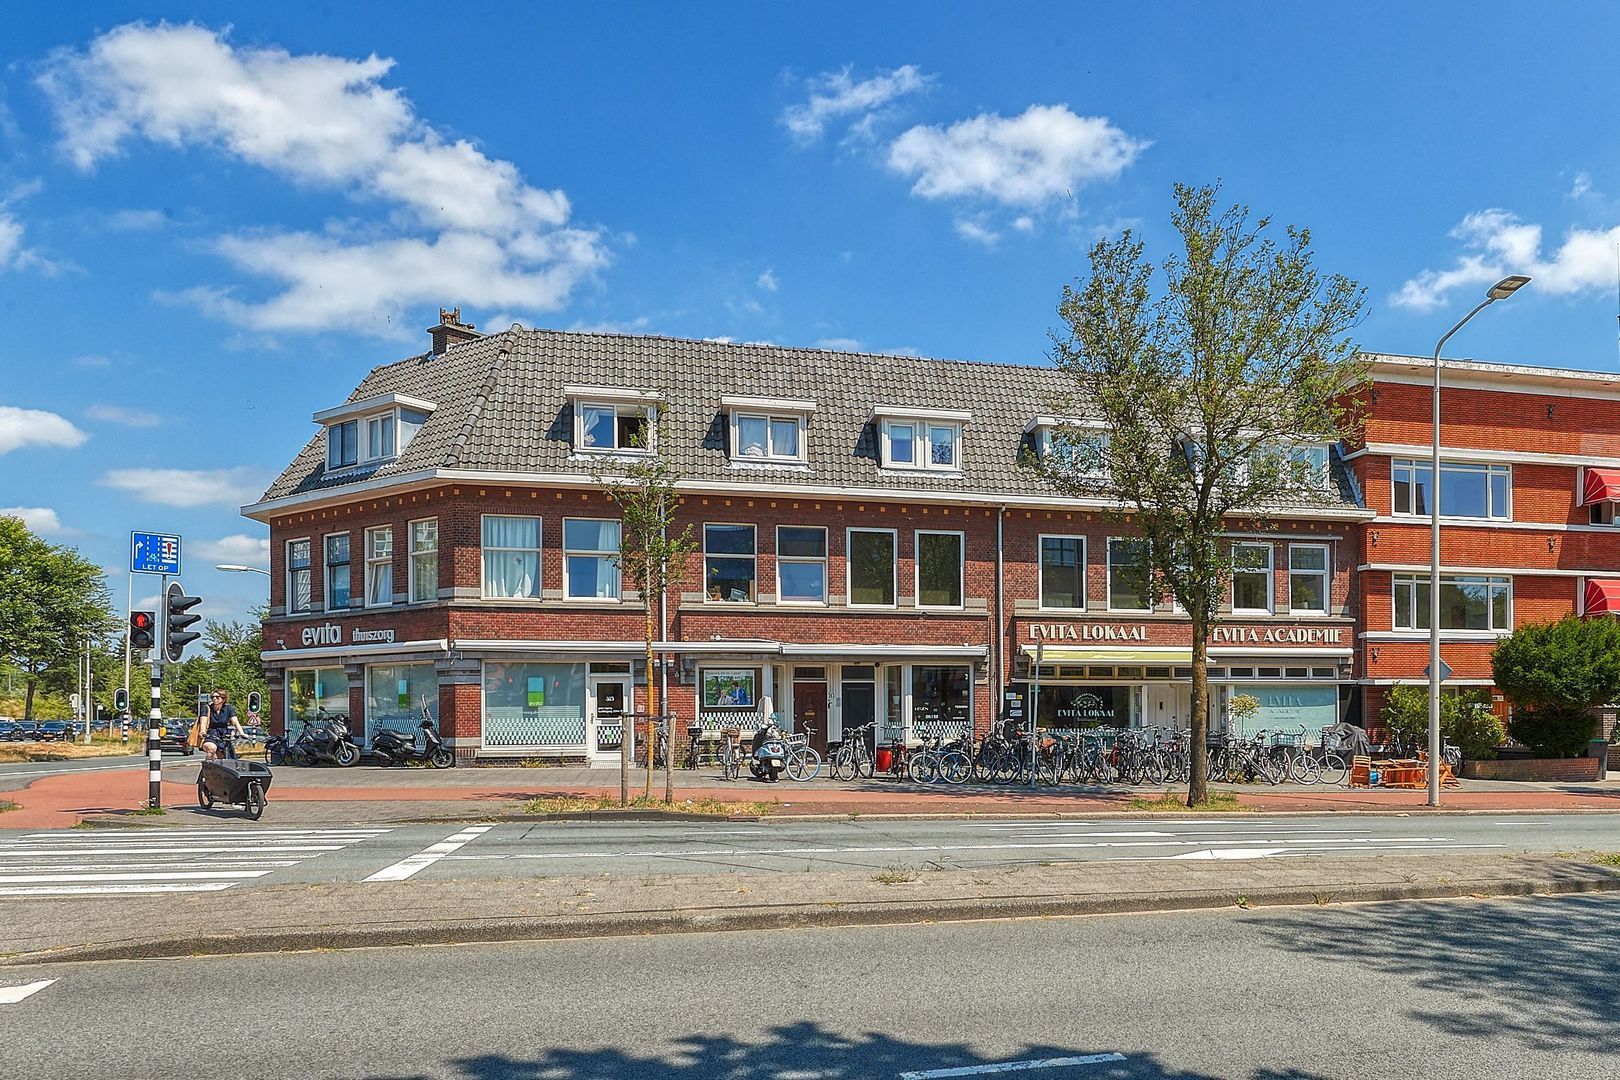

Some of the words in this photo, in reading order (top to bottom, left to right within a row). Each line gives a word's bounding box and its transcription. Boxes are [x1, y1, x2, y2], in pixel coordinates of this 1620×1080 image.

[302, 622, 342, 646] evita
[352, 627, 395, 643] thuiszorg
[1029, 624, 1078, 640] EVITA
[1083, 625, 1150, 640] LOKAAL
[1213, 627, 1259, 641] EVITA
[1263, 628, 1343, 643] ACADEMIE
[1057, 709, 1082, 717] EVITA
[1083, 709, 1115, 717] LOKAAL
